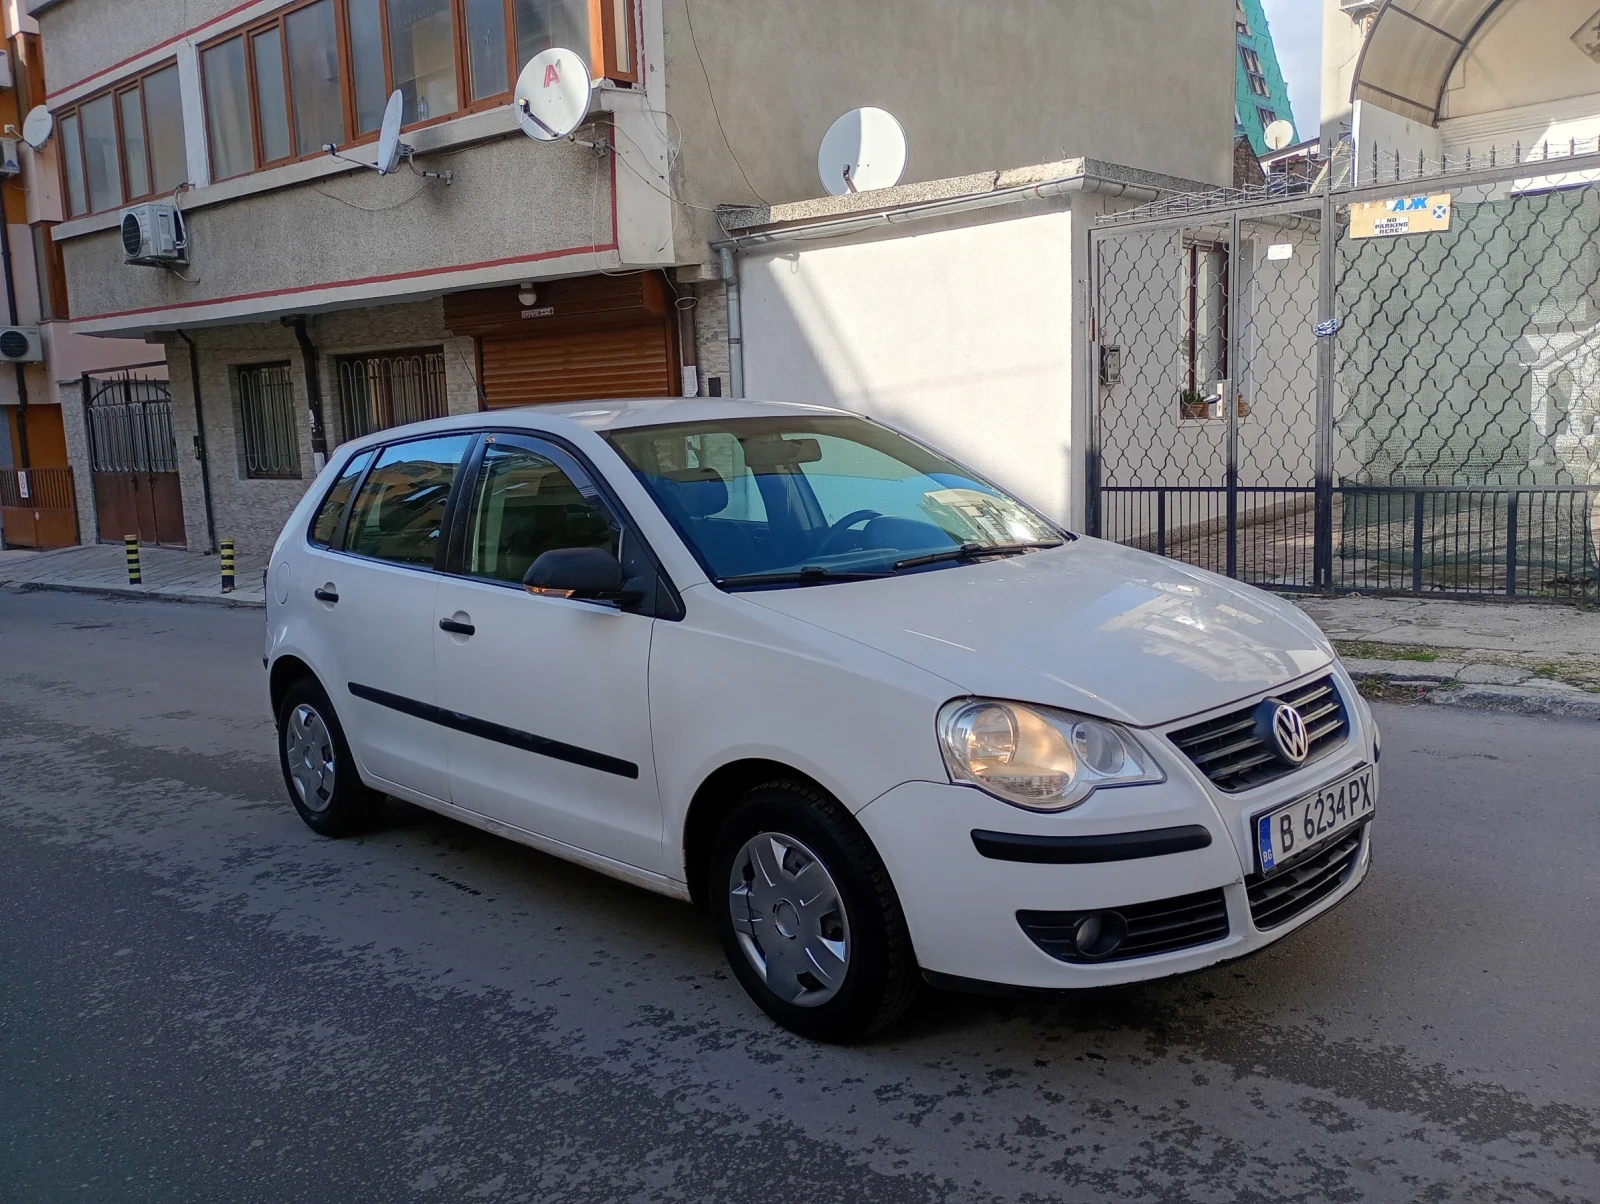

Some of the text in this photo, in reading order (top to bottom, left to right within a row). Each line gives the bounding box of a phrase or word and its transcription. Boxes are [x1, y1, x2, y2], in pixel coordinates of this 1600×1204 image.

[1374, 221, 1409, 230] PARKING
[1279, 813, 1295, 854] B
[1262, 849, 1273, 863] BG
